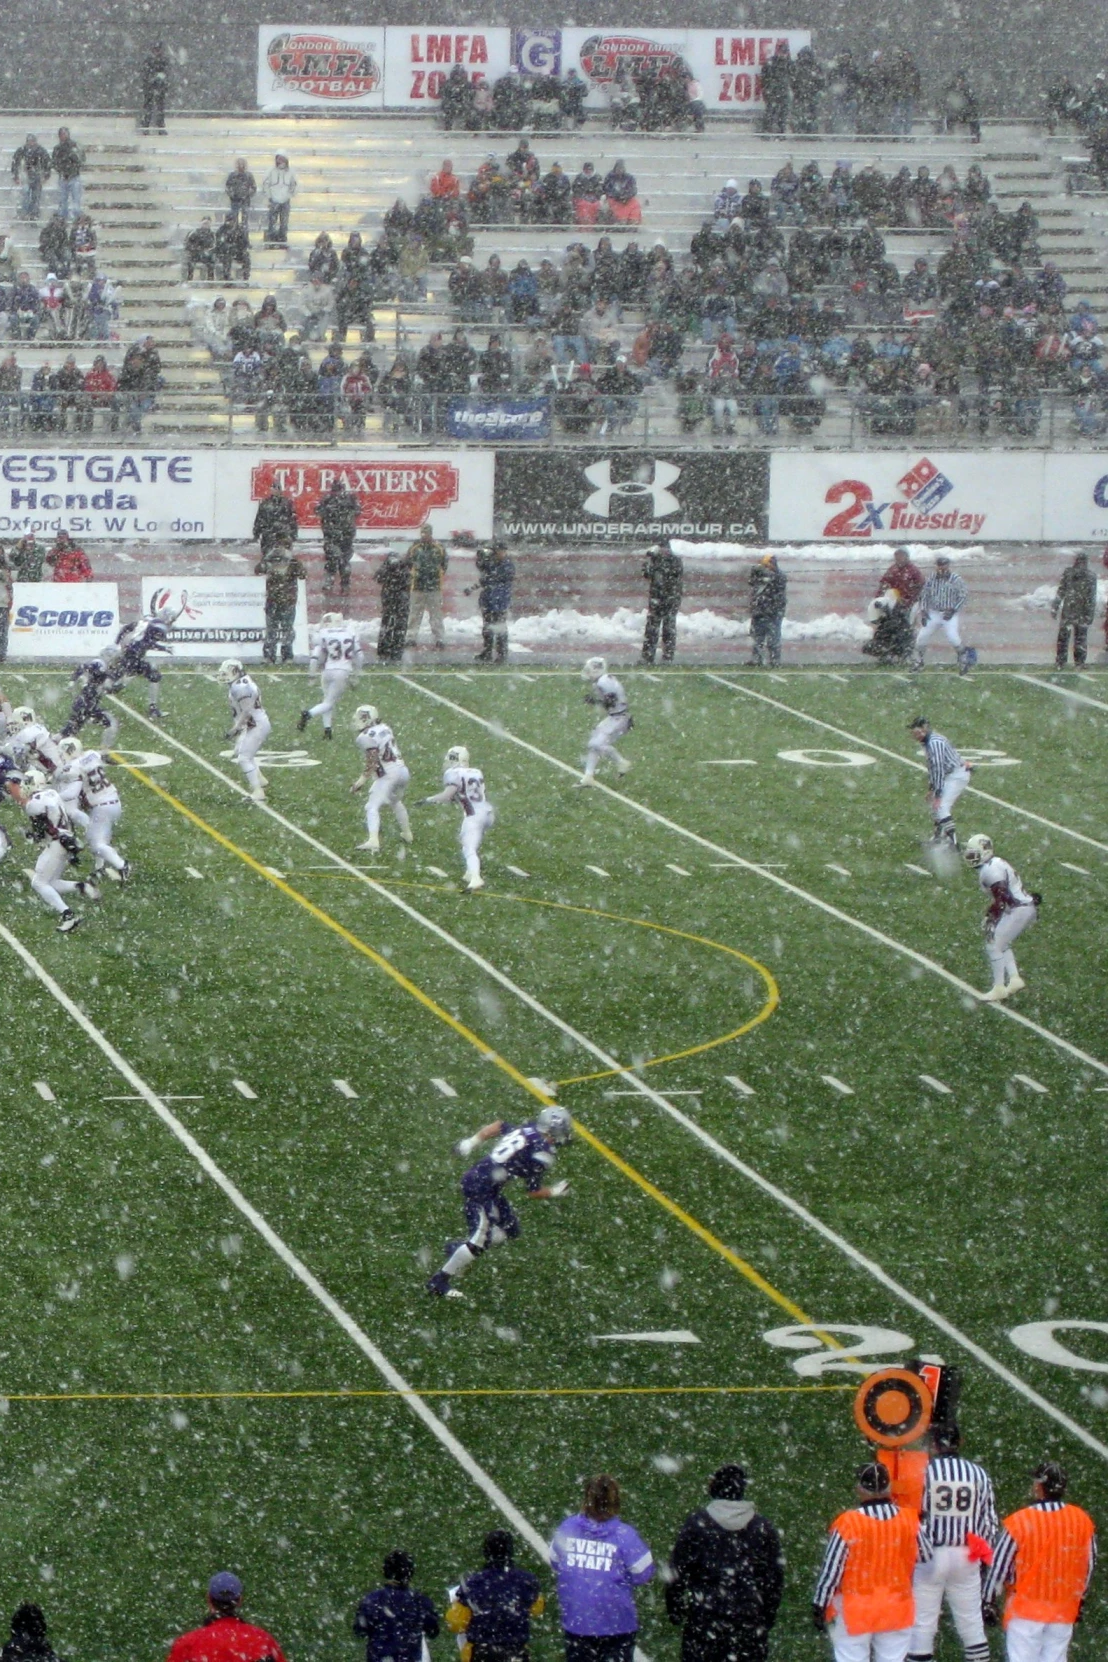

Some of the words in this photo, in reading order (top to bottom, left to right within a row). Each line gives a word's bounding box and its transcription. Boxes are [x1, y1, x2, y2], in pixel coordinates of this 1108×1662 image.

[282, 40, 332, 50] LONDON
[410, 34, 489, 64] LMFA
[521, 36, 555, 75] G
[594, 43, 644, 52] LONDON
[278, 54, 376, 77] LMFA
[271, 79, 385, 92] FOOTBALL
[275, 469, 312, 498] T.J.
[320, 469, 439, 493] BAXTER'S
[10, 488, 138, 511] Honda
[104, 517, 127, 533] W
[133, 516, 204, 533] Lodon
[888, 501, 987, 535] Tuesday
[15, 605, 115, 628] Score
[919, 1365, 941, 1412] 1
[935, 1485, 972, 1512] 38
[565, 1537, 618, 1557] EVENT
[566, 1553, 613, 1572] STAFF
